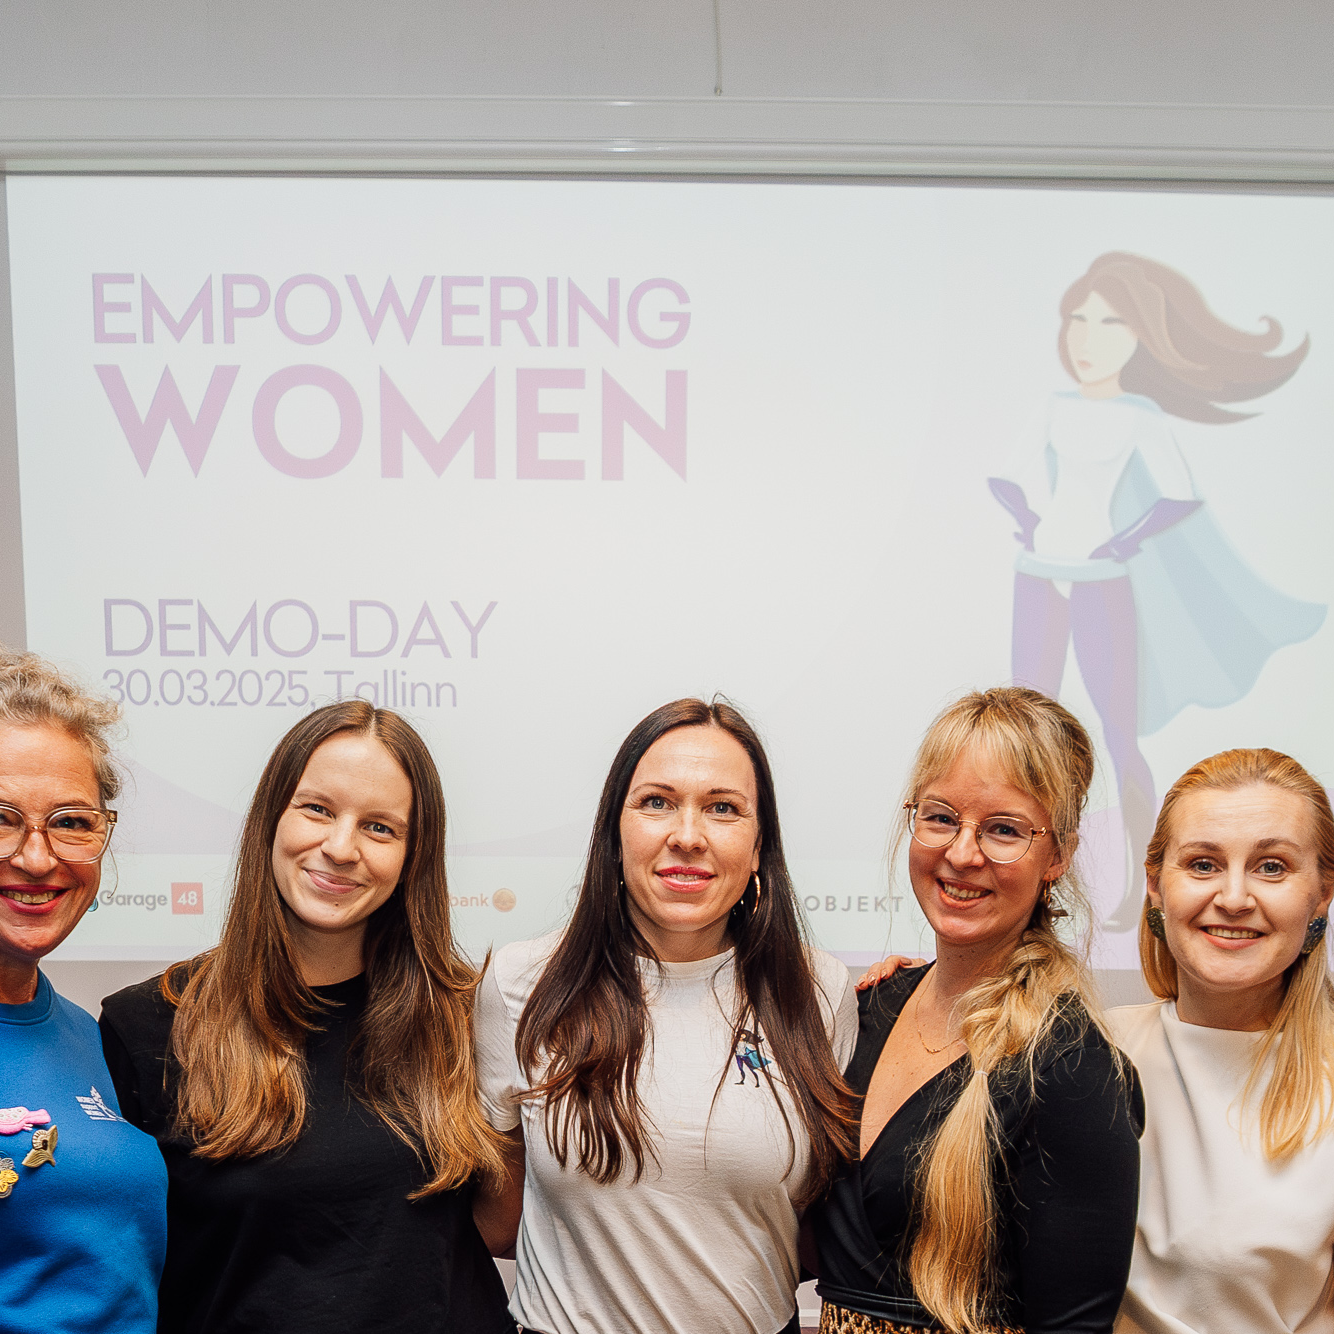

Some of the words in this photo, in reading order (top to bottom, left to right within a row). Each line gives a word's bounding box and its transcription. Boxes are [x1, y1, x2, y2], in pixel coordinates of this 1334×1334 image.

[91, 272, 692, 350] EMPOWERING
[92, 363, 689, 484] WOMEN
[102, 598, 499, 660] DEMO-DAY
[102, 668, 317, 710] 30.03.2025,
[323, 669, 458, 708] Tallinn
[99, 890, 168, 911] Garage
[177, 891, 198, 906] 48
[804, 895, 904, 912] OBJEKT
